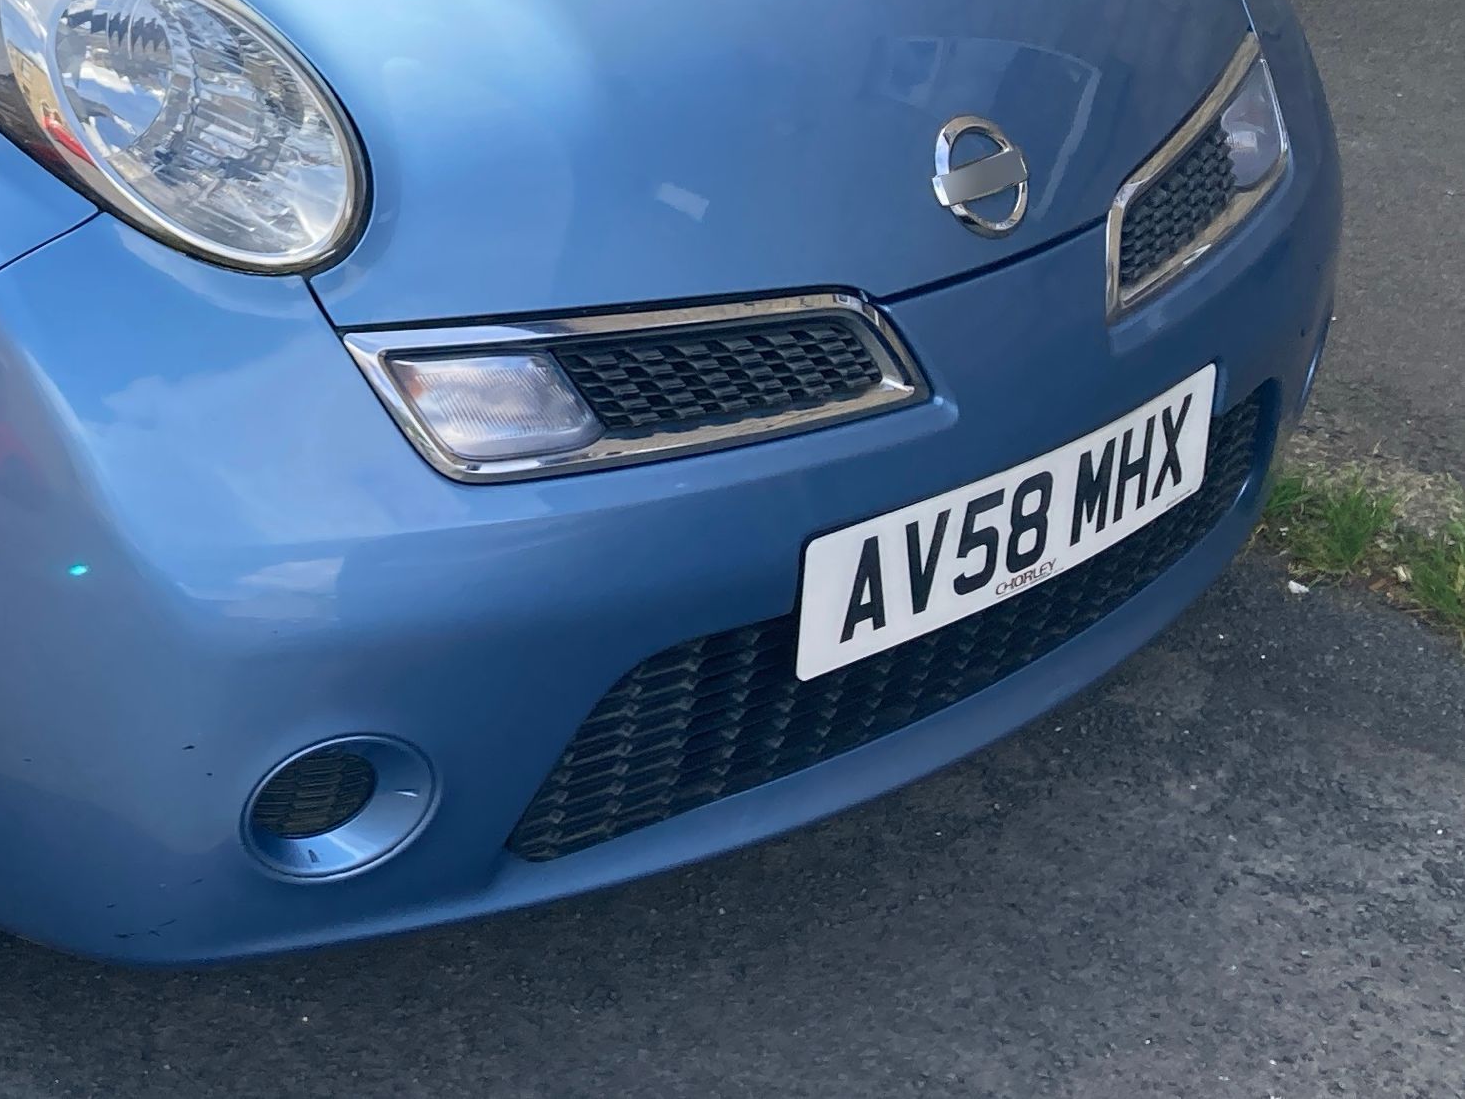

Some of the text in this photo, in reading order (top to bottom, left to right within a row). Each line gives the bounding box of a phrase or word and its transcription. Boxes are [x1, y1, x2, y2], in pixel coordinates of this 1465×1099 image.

[839, 393, 1193, 644] AV58 MHX
[995, 557, 1057, 596] CHORLEY
